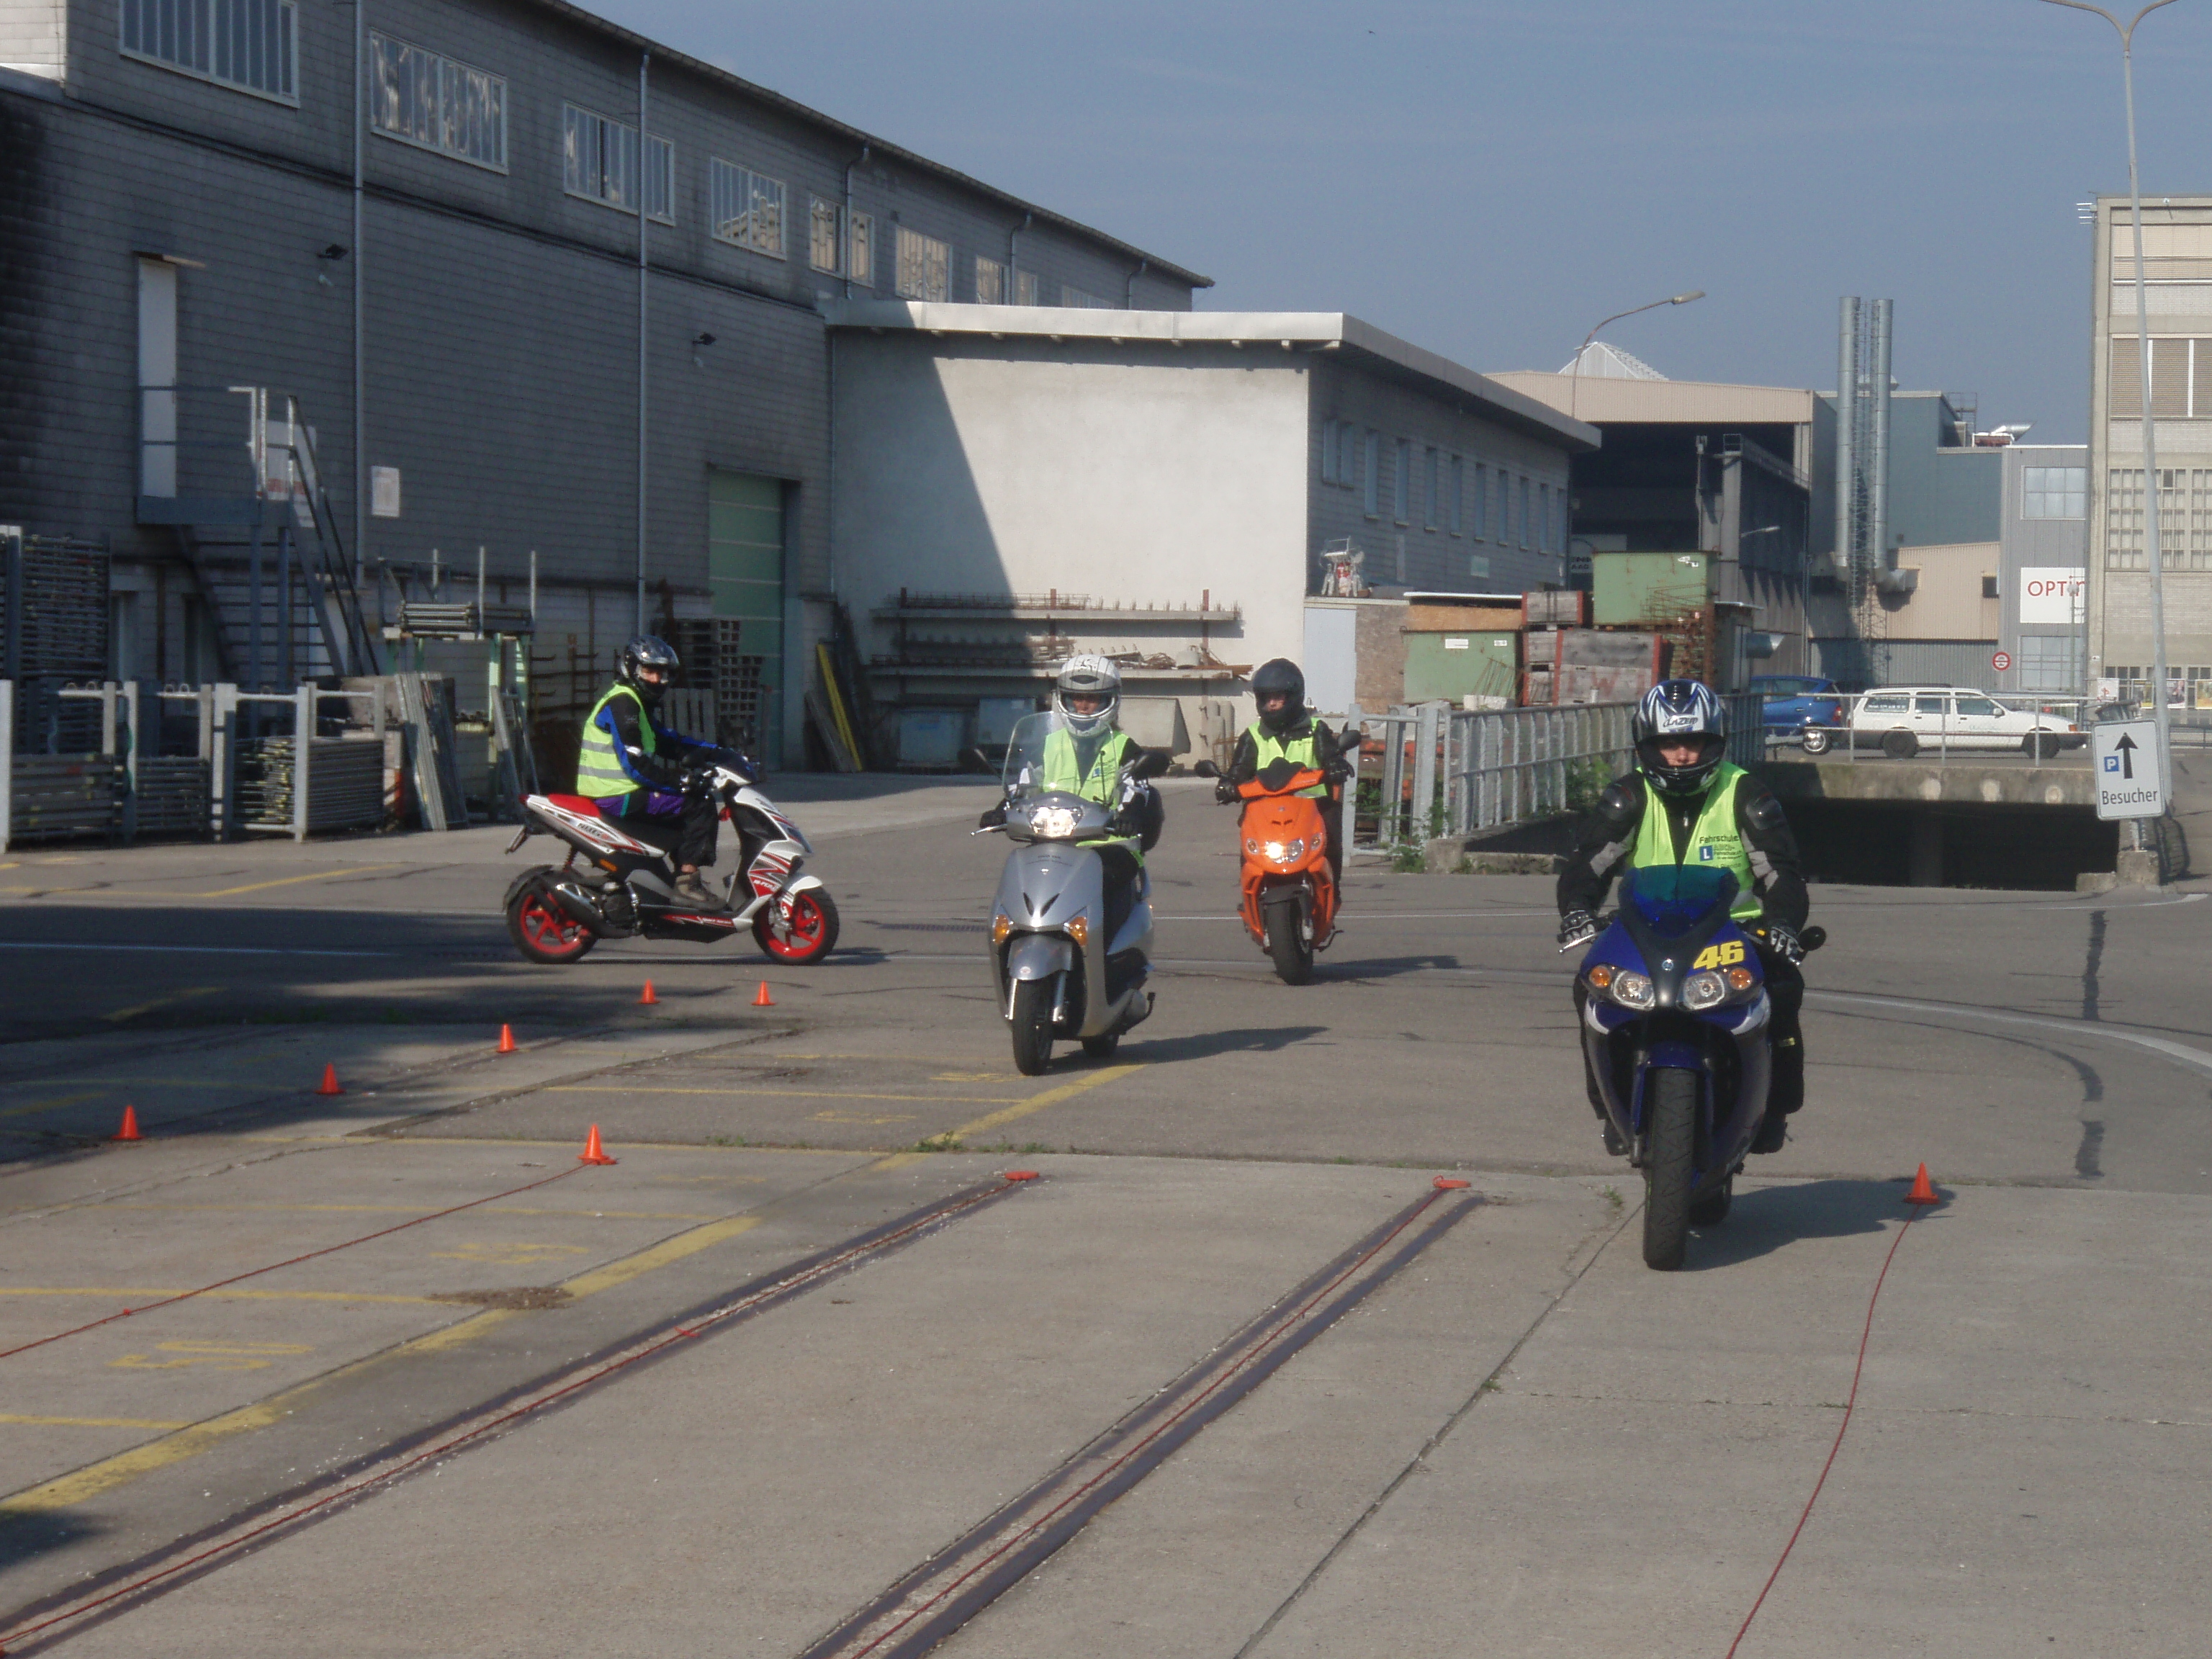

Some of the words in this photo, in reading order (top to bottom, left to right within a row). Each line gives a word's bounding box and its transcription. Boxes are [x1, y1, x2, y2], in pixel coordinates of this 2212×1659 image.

[2106, 758, 2117, 770] P
[2102, 787, 2158, 805] Besucher
[1699, 834, 1740, 843] Fahrschule
[1703, 848, 1710, 860] L
[1693, 940, 1744, 970] 46
